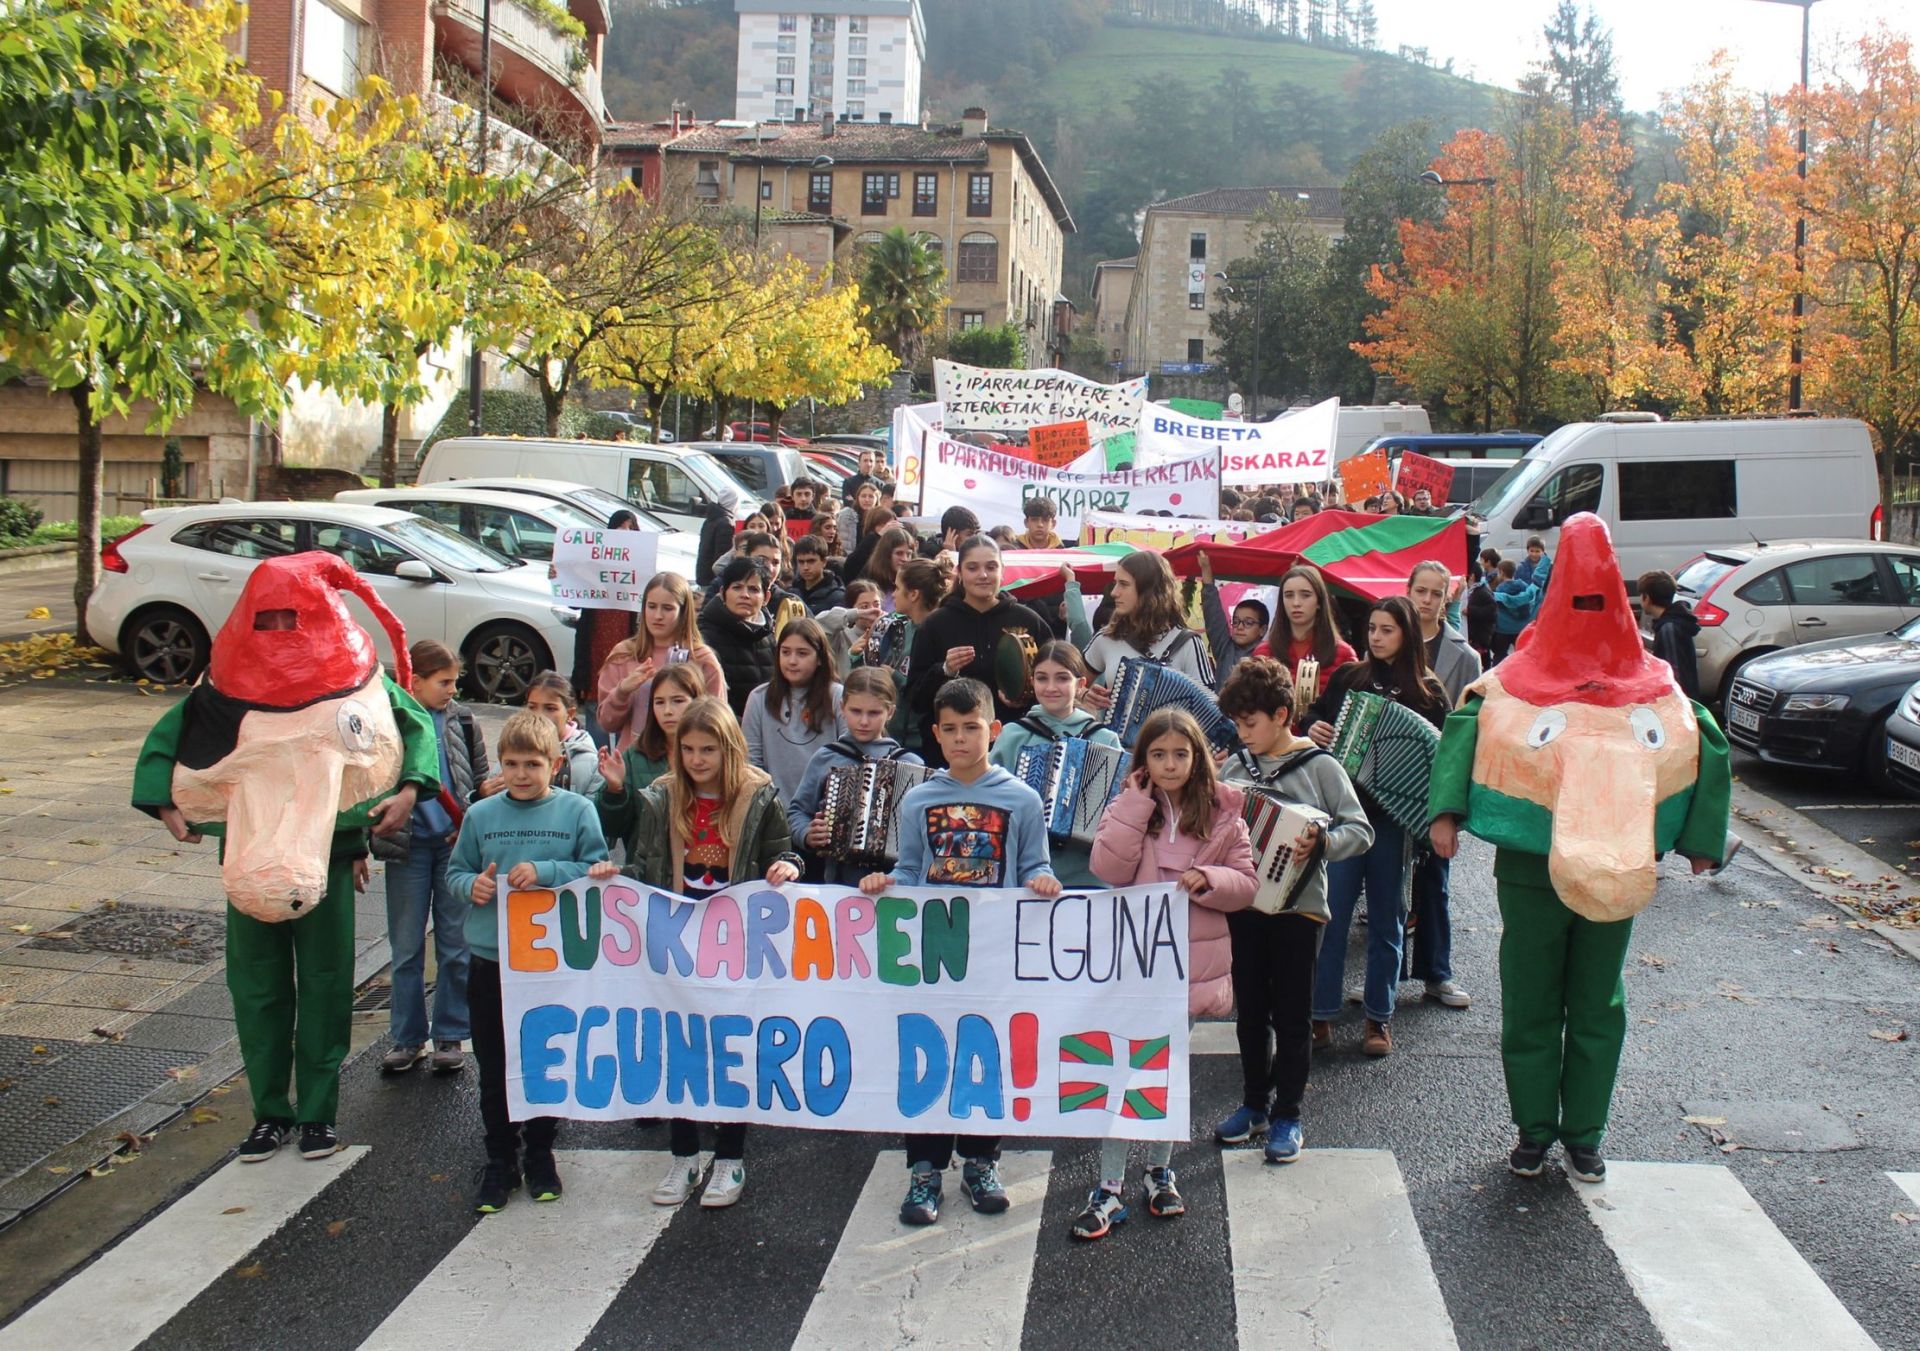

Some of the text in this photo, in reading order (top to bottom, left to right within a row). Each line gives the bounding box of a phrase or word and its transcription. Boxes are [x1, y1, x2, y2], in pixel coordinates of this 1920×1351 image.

[966, 377, 1113, 402] IPARRALDEAN ERE
[1153, 417, 1262, 441] BREBETA
[1057, 471, 1086, 483] ere
[562, 530, 604, 545] GAUR
[591, 545, 630, 561] BIHAR
[600, 570, 636, 585] ETZI
[517, 830, 571, 841] INDUSTRIES
[507, 884, 1185, 986] EUSKARAREN EGUNA
[519, 1004, 1039, 1122] EGUNERO DA!
